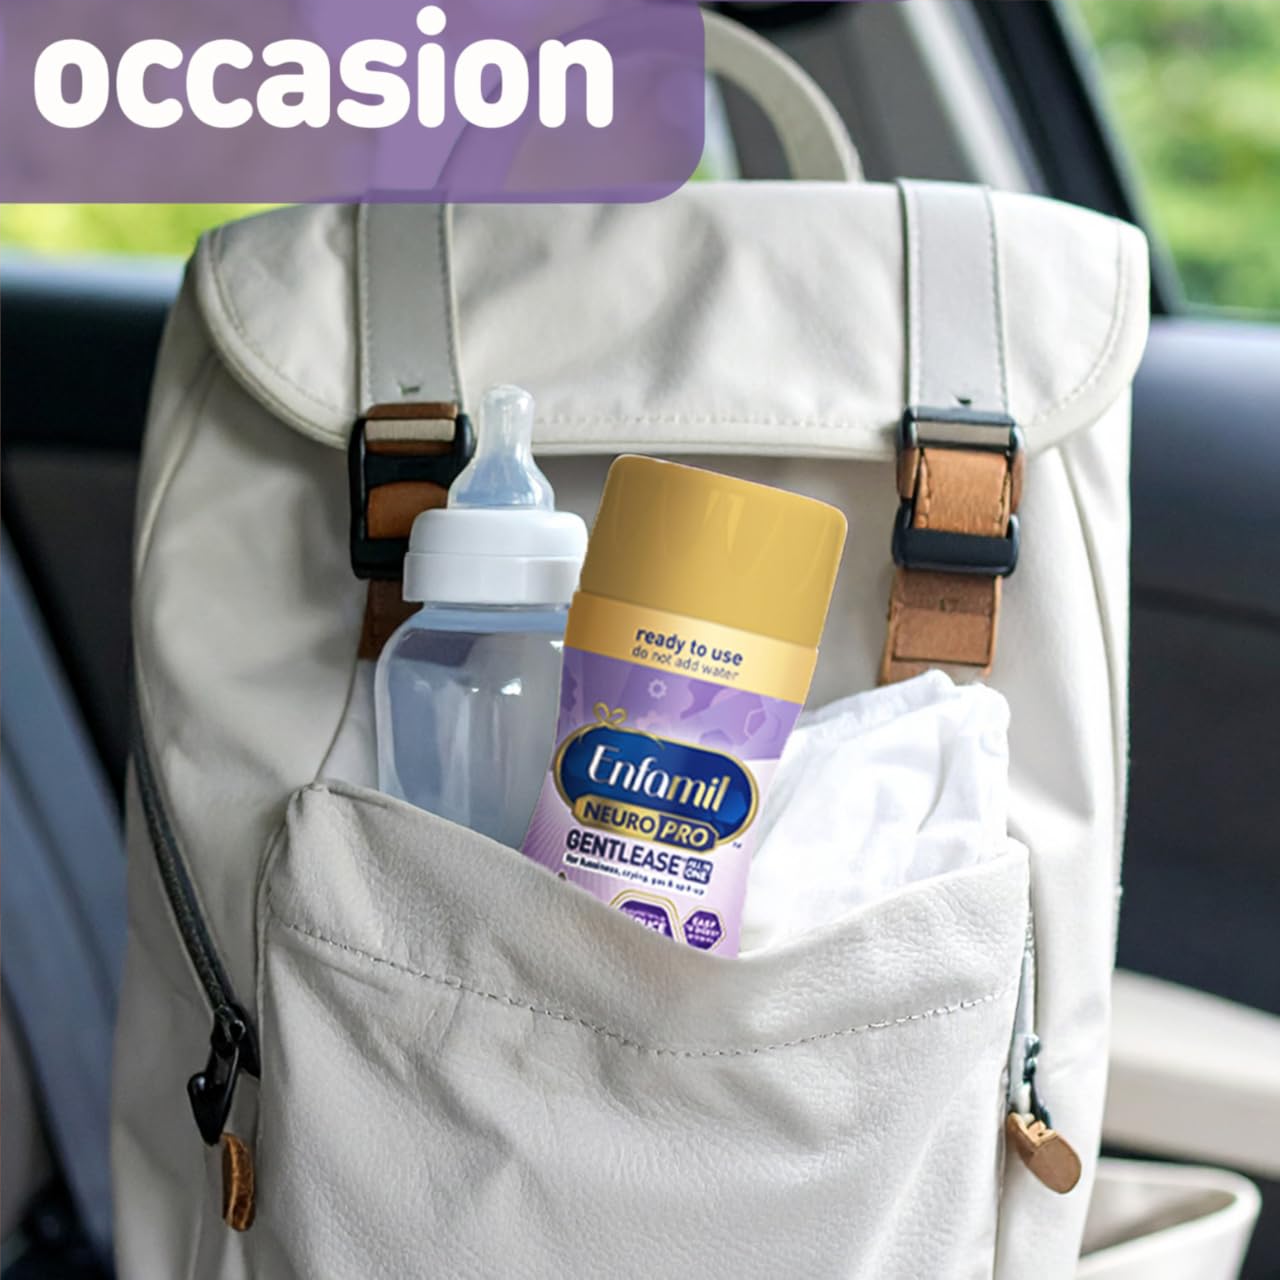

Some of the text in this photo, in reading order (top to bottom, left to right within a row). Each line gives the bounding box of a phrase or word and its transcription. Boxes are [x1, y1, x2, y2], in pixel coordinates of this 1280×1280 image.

[631, 645, 740, 680] do not add water
[635, 628, 743, 666] ready to use
[586, 742, 731, 814] Enfamil
[583, 801, 656, 834] NEURO
[660, 821, 709, 847] PRO
